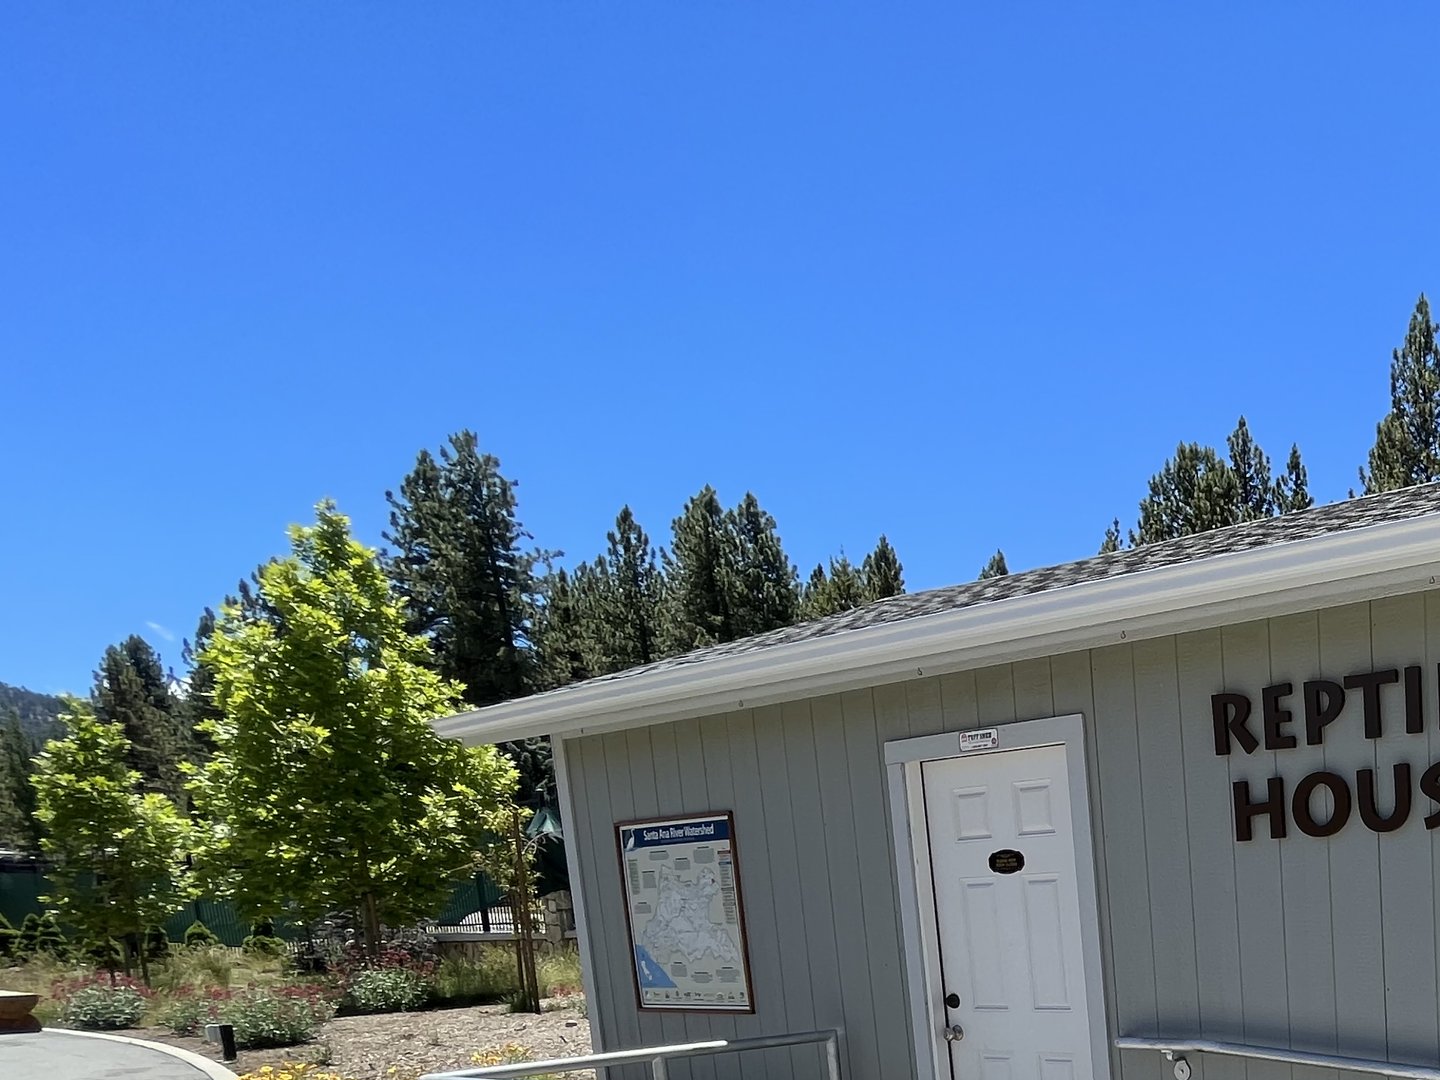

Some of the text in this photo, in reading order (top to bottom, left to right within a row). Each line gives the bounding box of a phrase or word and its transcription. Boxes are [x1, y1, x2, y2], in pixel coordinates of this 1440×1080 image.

[643, 830, 659, 841] Santa
[659, 829, 670, 839] Ana
[669, 827, 684, 839] River
[683, 823, 714, 836] Watershed
